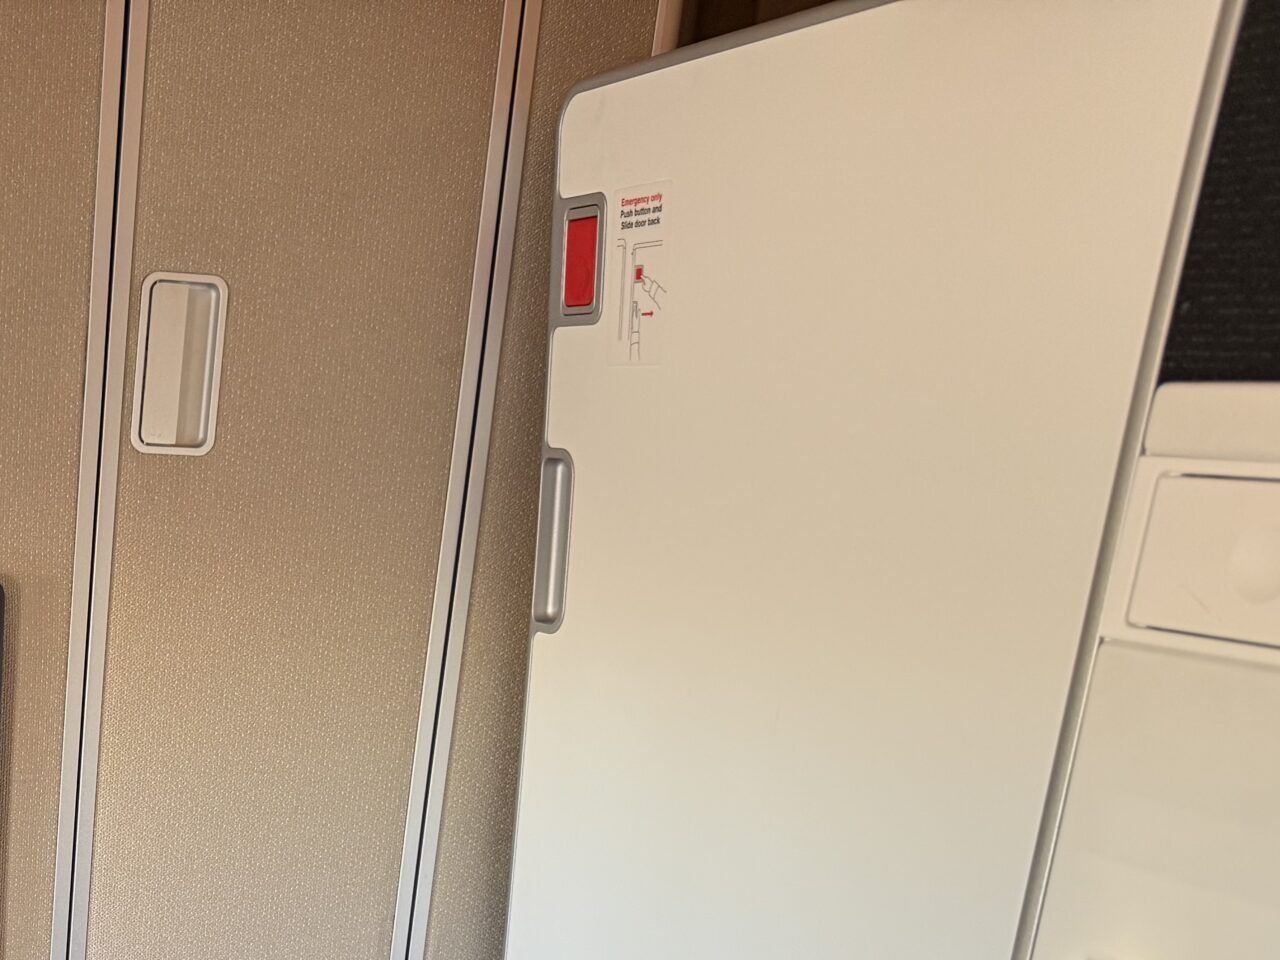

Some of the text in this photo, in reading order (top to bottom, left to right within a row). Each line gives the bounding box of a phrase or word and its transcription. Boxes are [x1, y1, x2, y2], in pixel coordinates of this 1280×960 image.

[621, 192, 662, 207] Emergency only
[620, 204, 662, 218] Push button and
[621, 217, 660, 230] Slide door back
